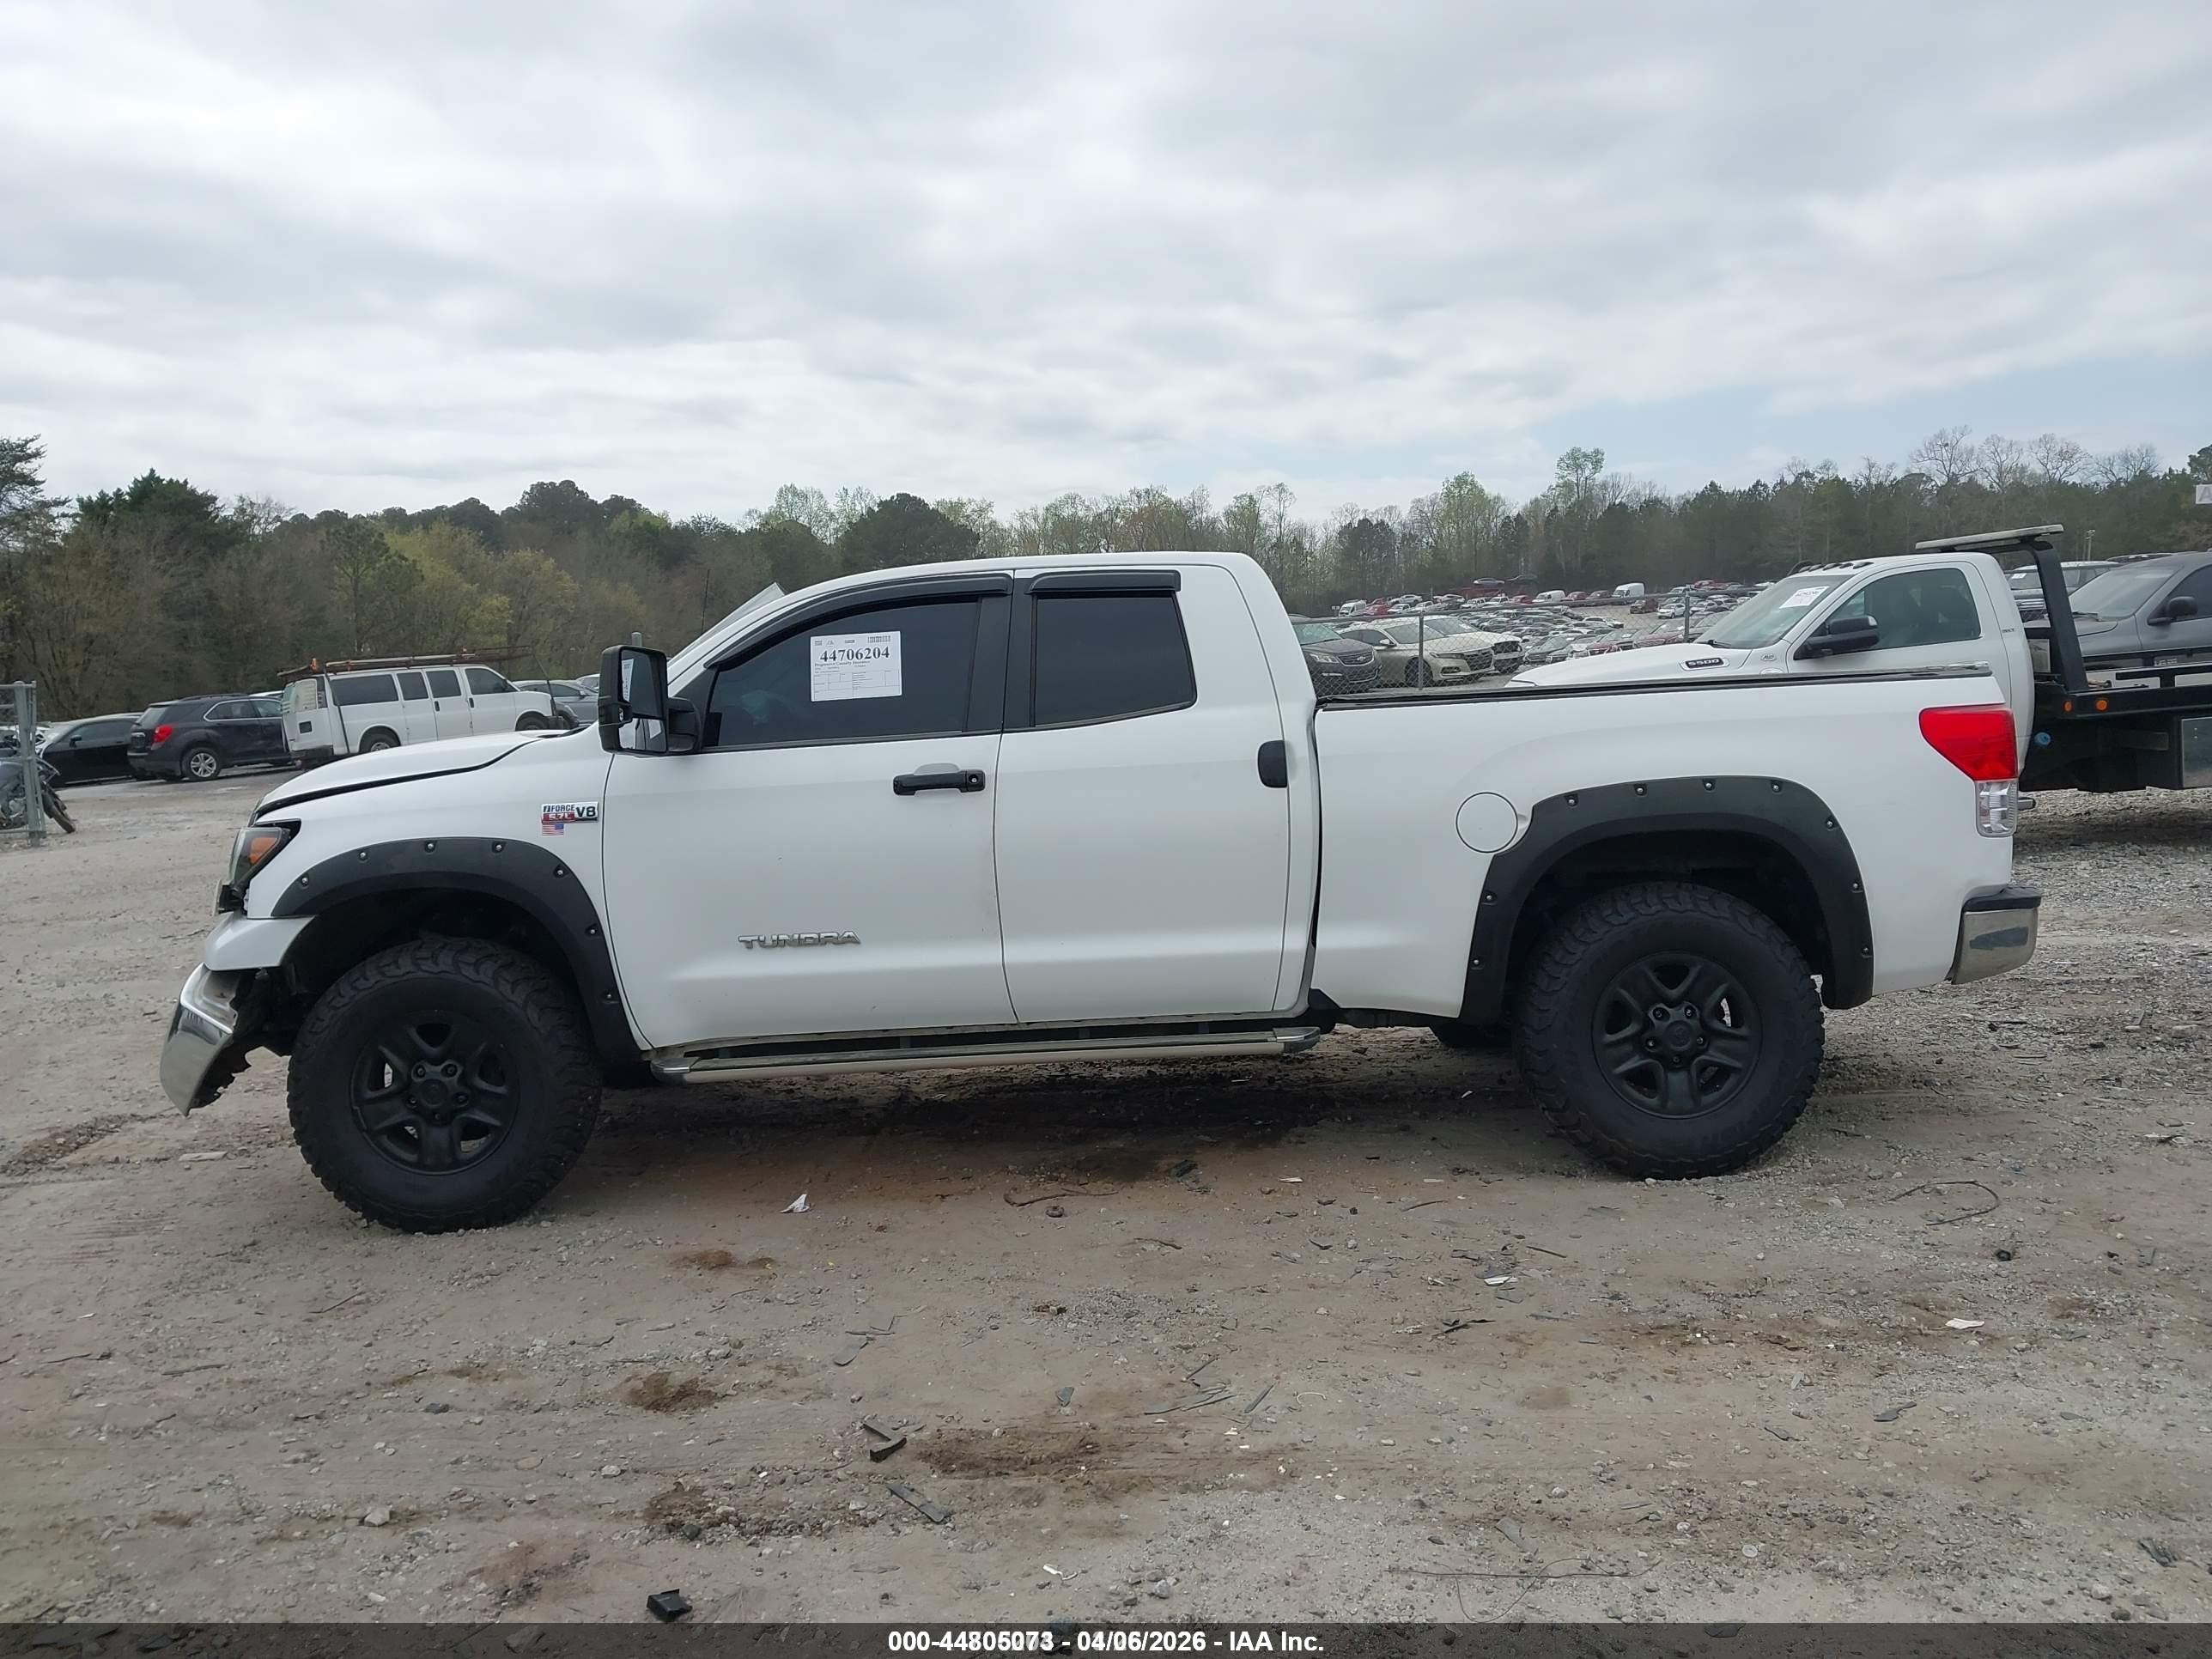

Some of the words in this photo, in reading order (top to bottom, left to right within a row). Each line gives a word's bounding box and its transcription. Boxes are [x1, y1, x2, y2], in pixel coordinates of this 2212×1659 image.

[820, 646, 890, 662] 44706204
[576, 805, 597, 818] V8
[738, 930, 862, 950] TUNDRA
